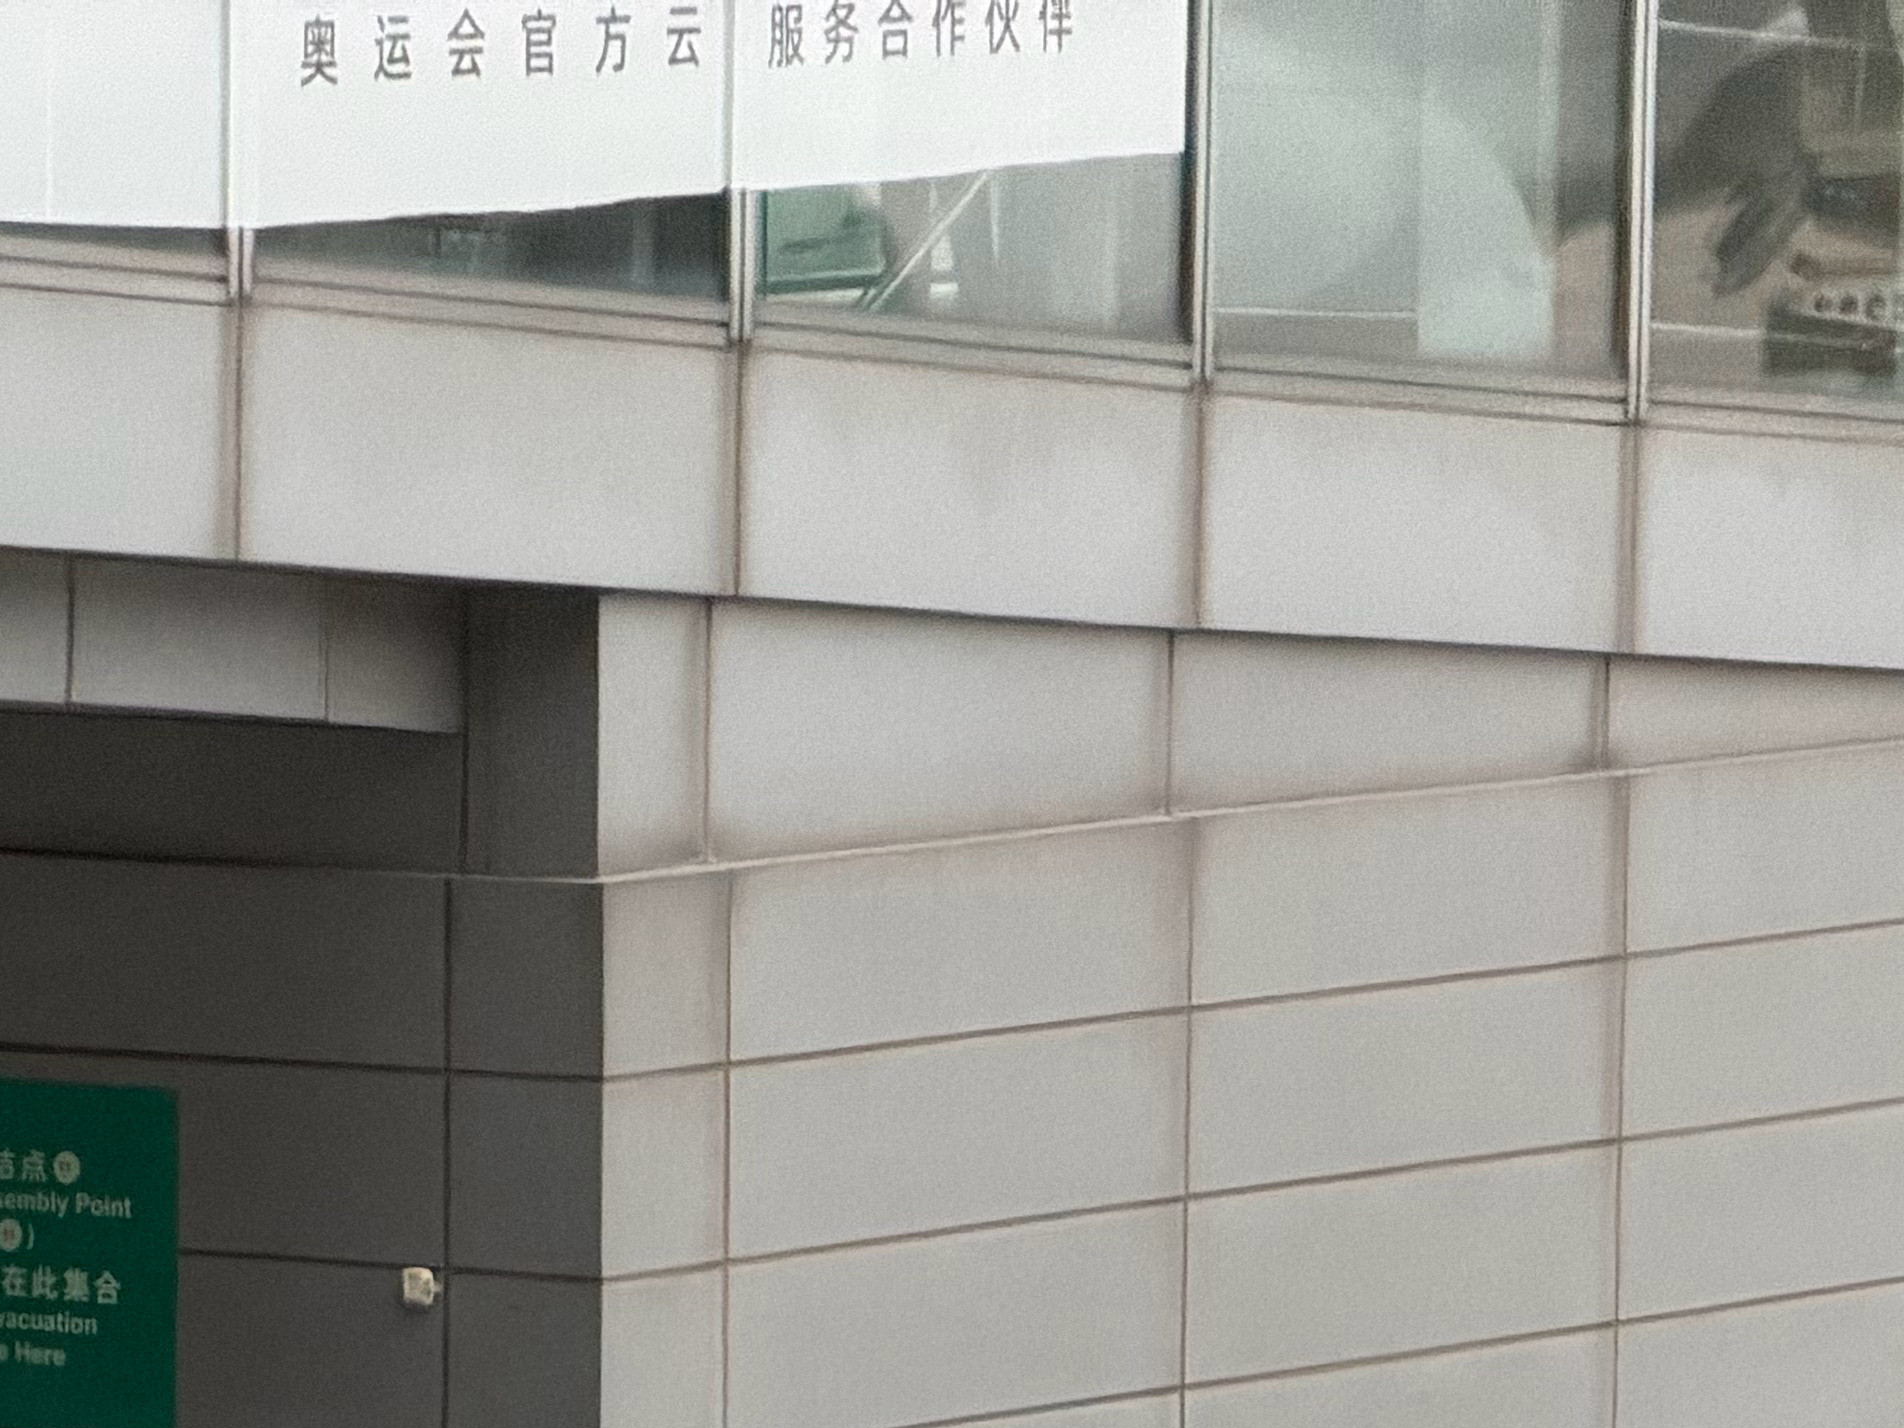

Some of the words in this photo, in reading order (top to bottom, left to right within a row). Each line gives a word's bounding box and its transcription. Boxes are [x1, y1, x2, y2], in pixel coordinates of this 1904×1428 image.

[300, 5, 702, 87] 奥运会官方云
[768, 0, 1073, 68] 服务合作伙伴
[76, 1192, 133, 1220] Point
[14, 1339, 67, 1368] Here
